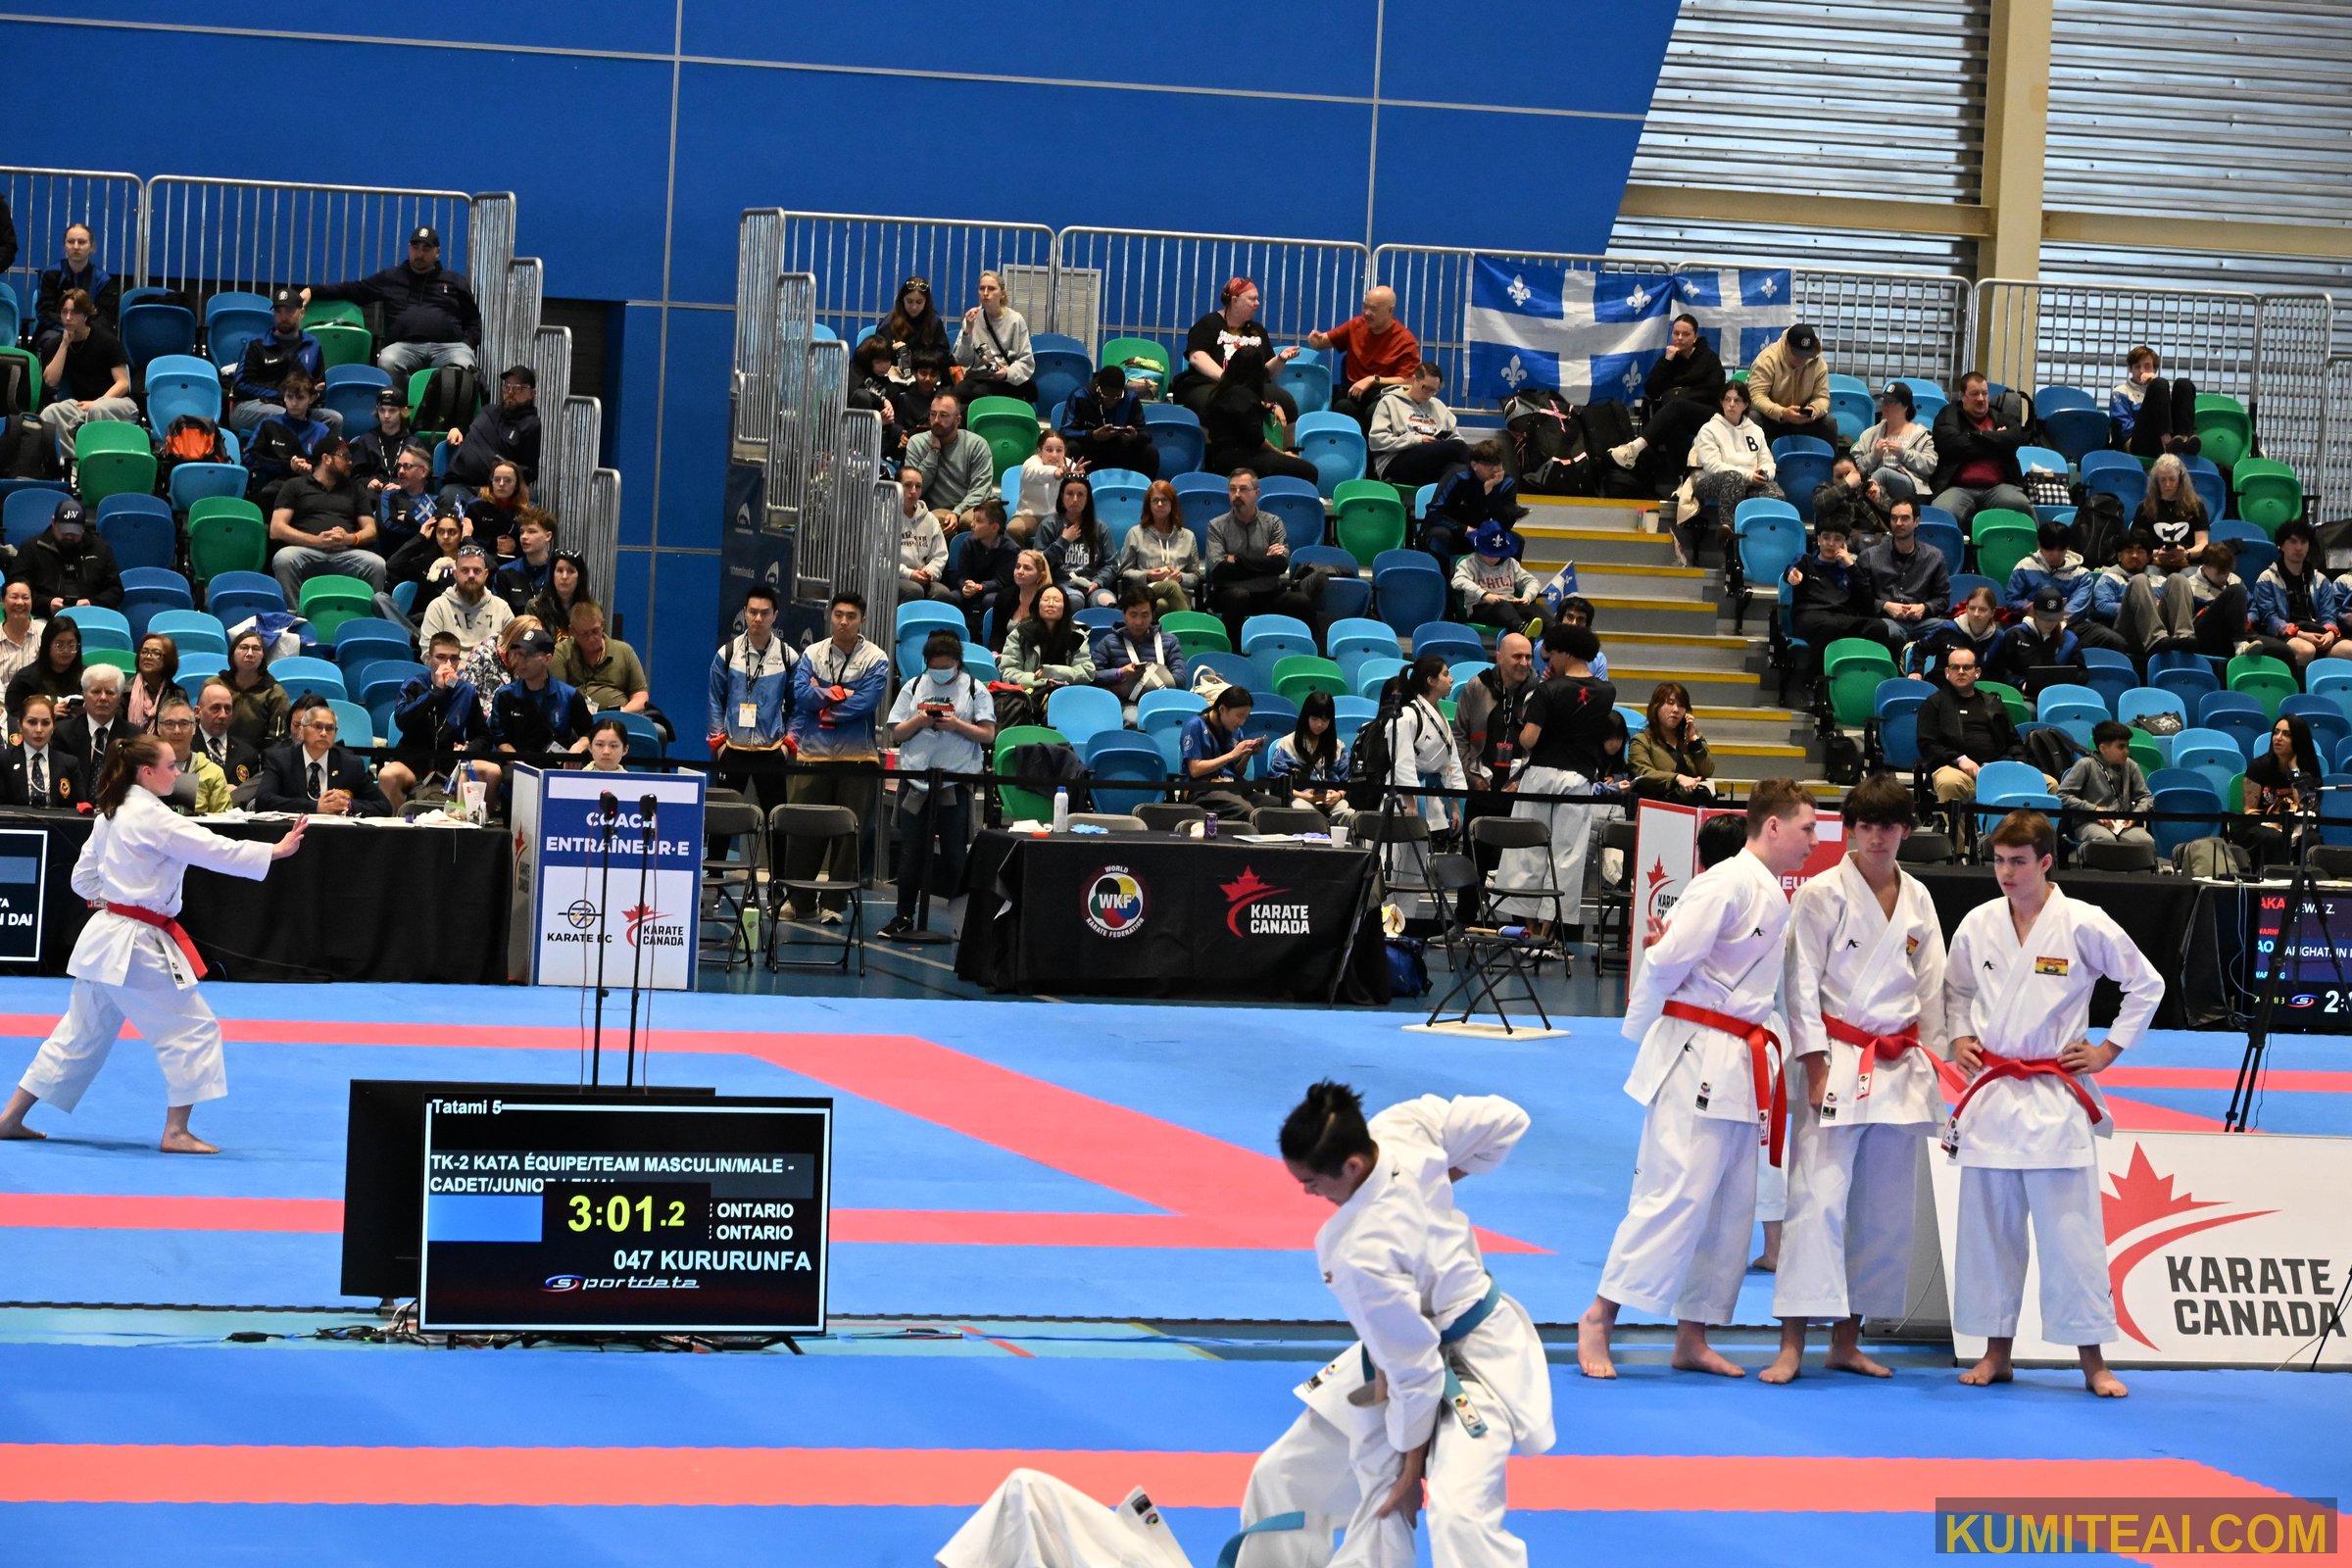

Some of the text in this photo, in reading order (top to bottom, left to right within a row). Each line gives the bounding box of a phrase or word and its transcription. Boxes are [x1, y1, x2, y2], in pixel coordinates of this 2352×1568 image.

[1745, 435, 1759, 452] B
[1104, 864, 1129, 873] WORLD
[1099, 893, 1132, 909] WKF
[8, 912, 33, 926] DAI
[1250, 904, 1309, 919] KARATE
[643, 925, 684, 936] KARATE
[1086, 917, 1145, 938] KARATE FEDERATION
[1250, 919, 1310, 934] CANADA
[547, 932, 594, 943] KARATE
[643, 936, 684, 947] CANADA
[432, 1099, 502, 1115] Tatami 5
[431, 1154, 469, 1170] TK-2
[473, 1154, 520, 1171] KATA
[524, 1152, 640, 1173] ÉQUIPE/TEAM
[644, 1156, 784, 1174] MASCULIN/MALE
[429, 1176, 556, 1194] CADET/JUNIO
[716, 1202, 795, 1218] ONTARIO
[716, 1224, 794, 1241] ONTARIO
[613, 1250, 812, 1271] 047 KURURUNFA
[2165, 1255, 2335, 1296] KARATE
[2174, 1298, 2347, 1338] CANADA
